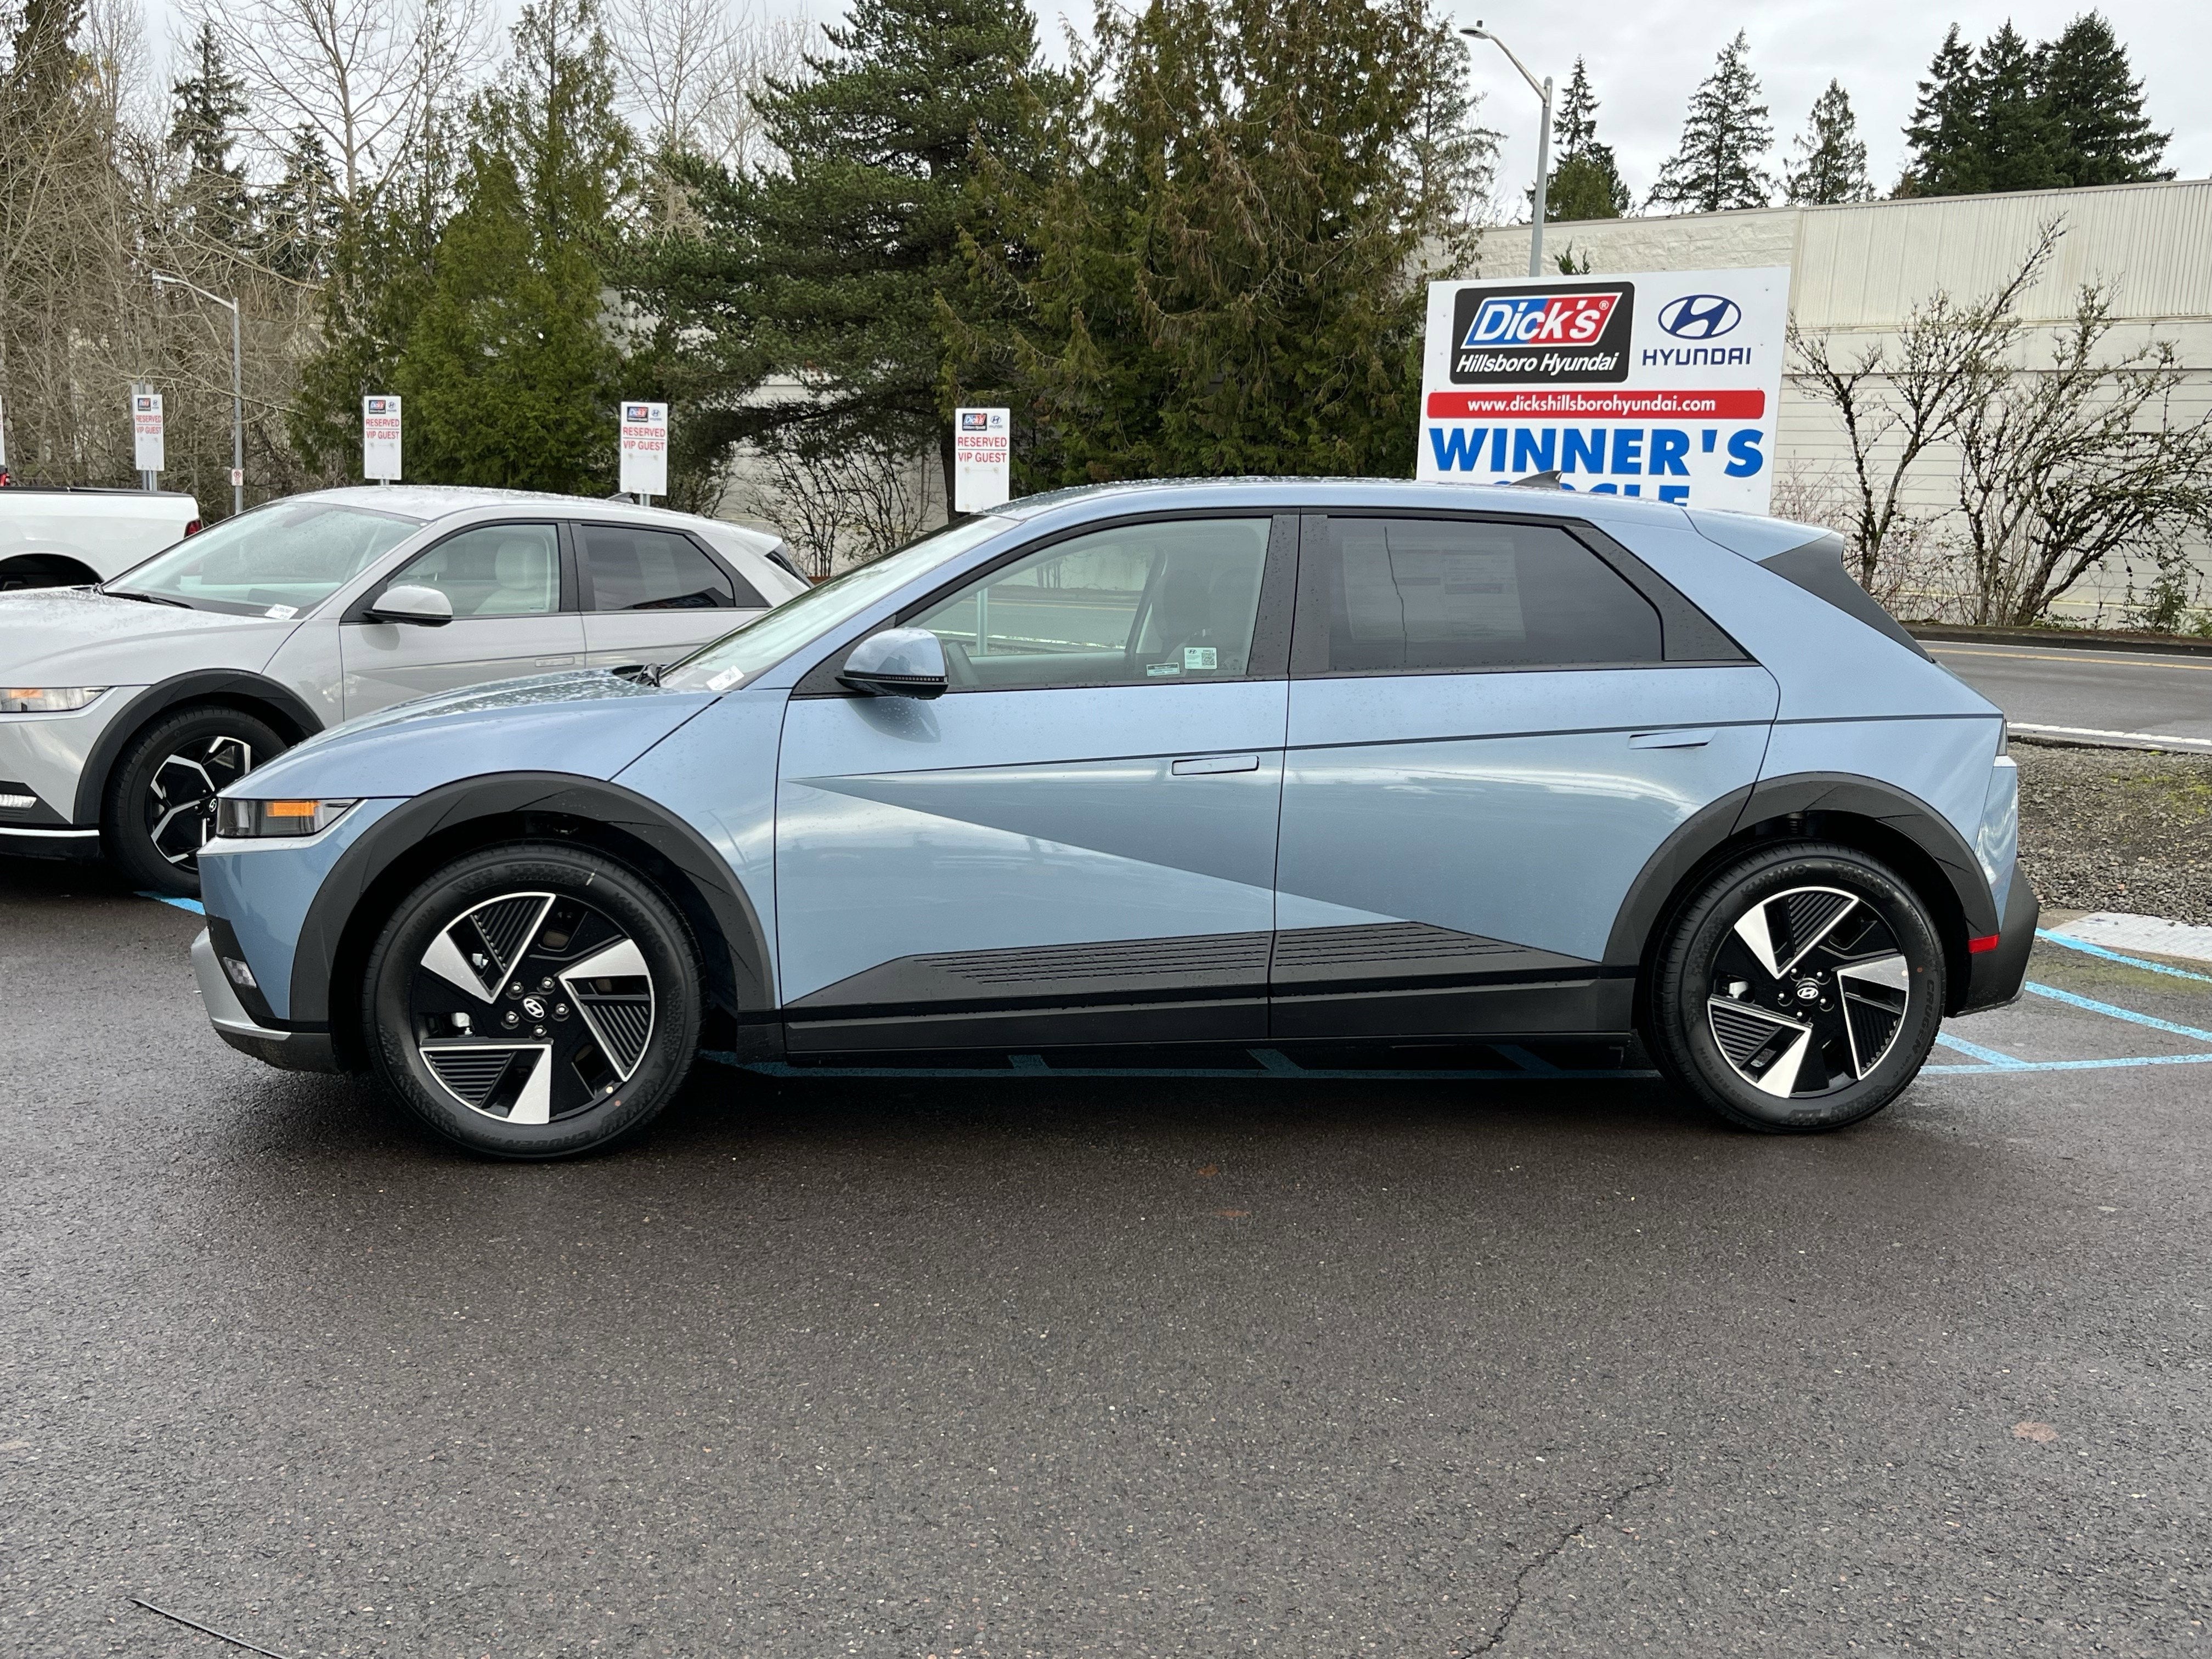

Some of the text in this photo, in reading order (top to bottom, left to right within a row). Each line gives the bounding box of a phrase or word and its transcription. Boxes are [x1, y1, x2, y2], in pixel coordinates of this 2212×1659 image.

[1642, 347, 1751, 365] HYUNDAI
[1455, 352, 1620, 376] Hillsboro Hyundai
[1468, 394, 1716, 416] www.dickshillsborohyundai.com
[136, 415, 162, 423] RESERVED
[366, 419, 399, 427] RESERVED
[379, 431, 399, 439] GUEST
[623, 427, 665, 437] RESERVED
[624, 441, 665, 450] VIP GUEST
[958, 437, 1007, 447] RESERVED
[958, 452, 1007, 462] VIP GUEST
[1429, 428, 1763, 478] WINNER'S
